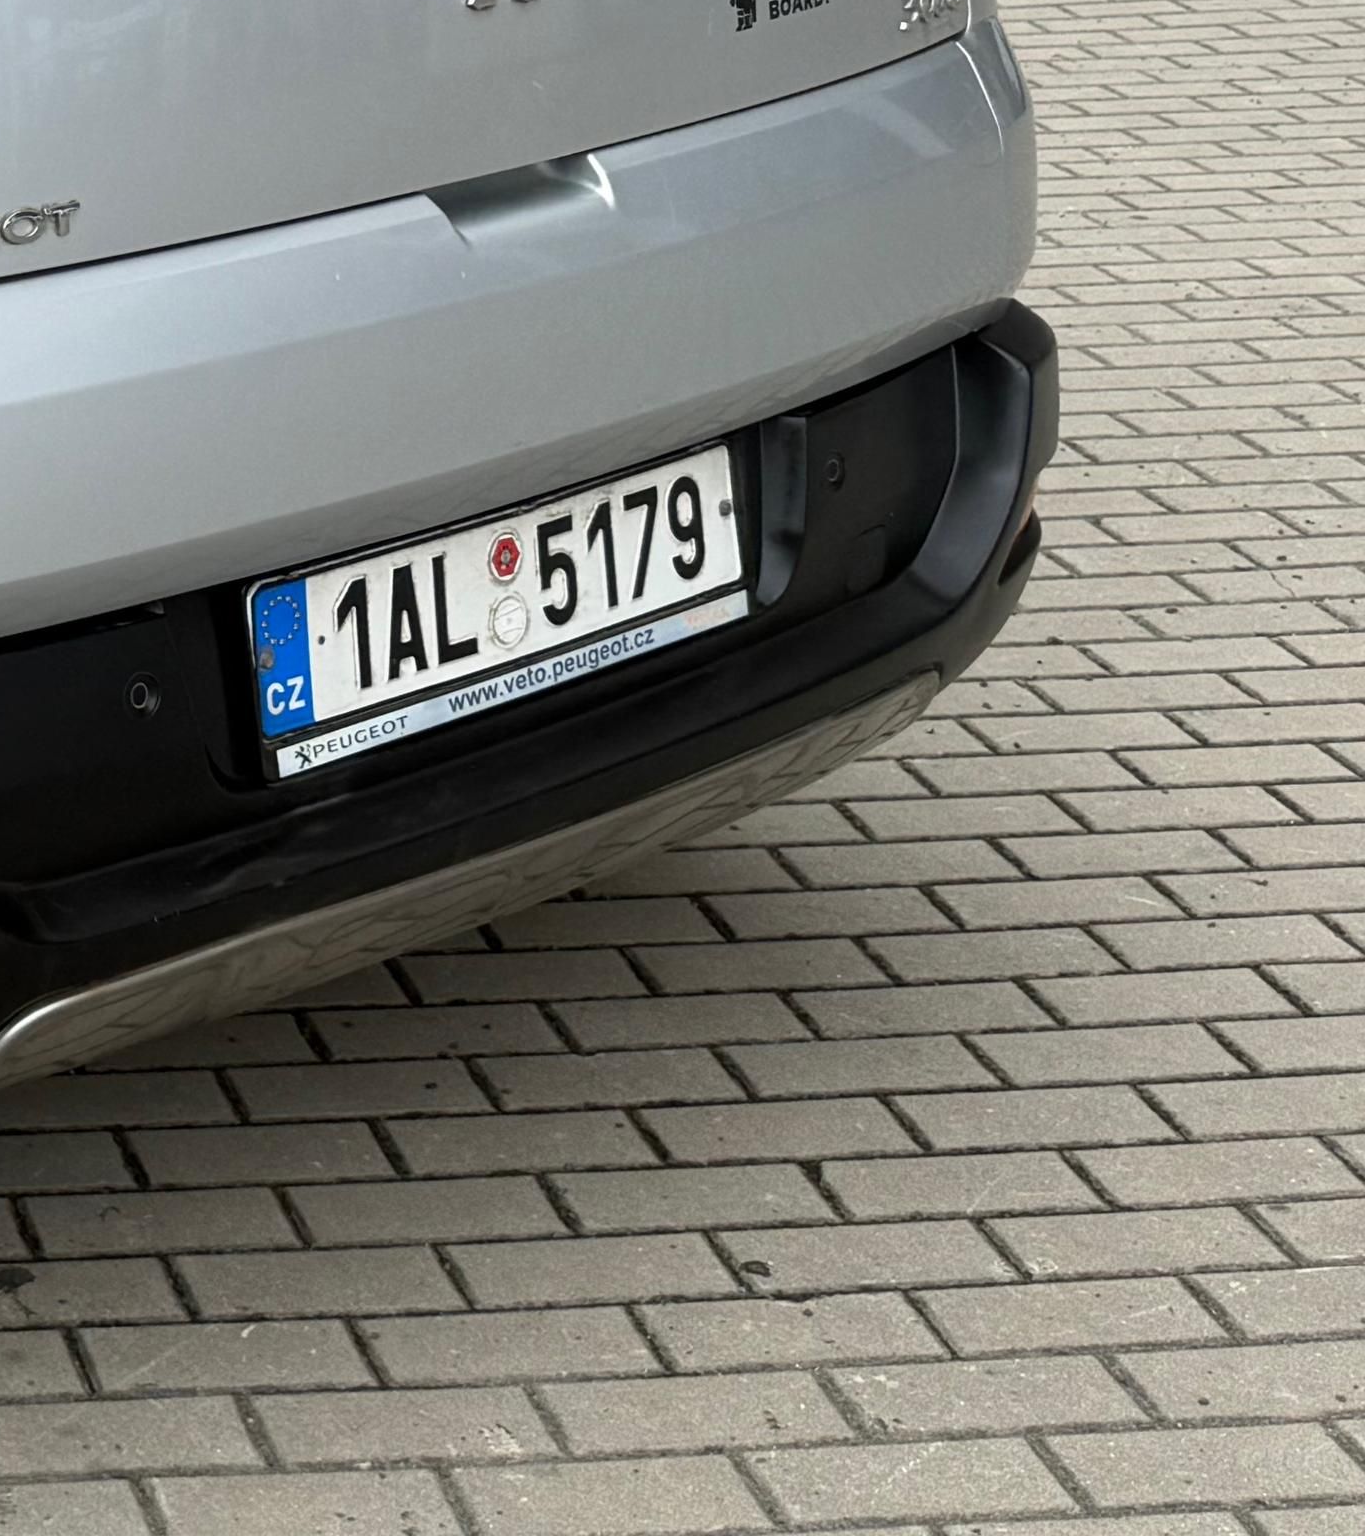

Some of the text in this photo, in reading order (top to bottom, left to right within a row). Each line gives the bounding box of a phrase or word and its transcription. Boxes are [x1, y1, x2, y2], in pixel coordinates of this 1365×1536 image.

[334, 475, 706, 690] 1AL 5179
[266, 675, 307, 716] CZ
[448, 627, 655, 714] www.veto.peugeot.cz
[312, 715, 409, 759] PEUGEOT
